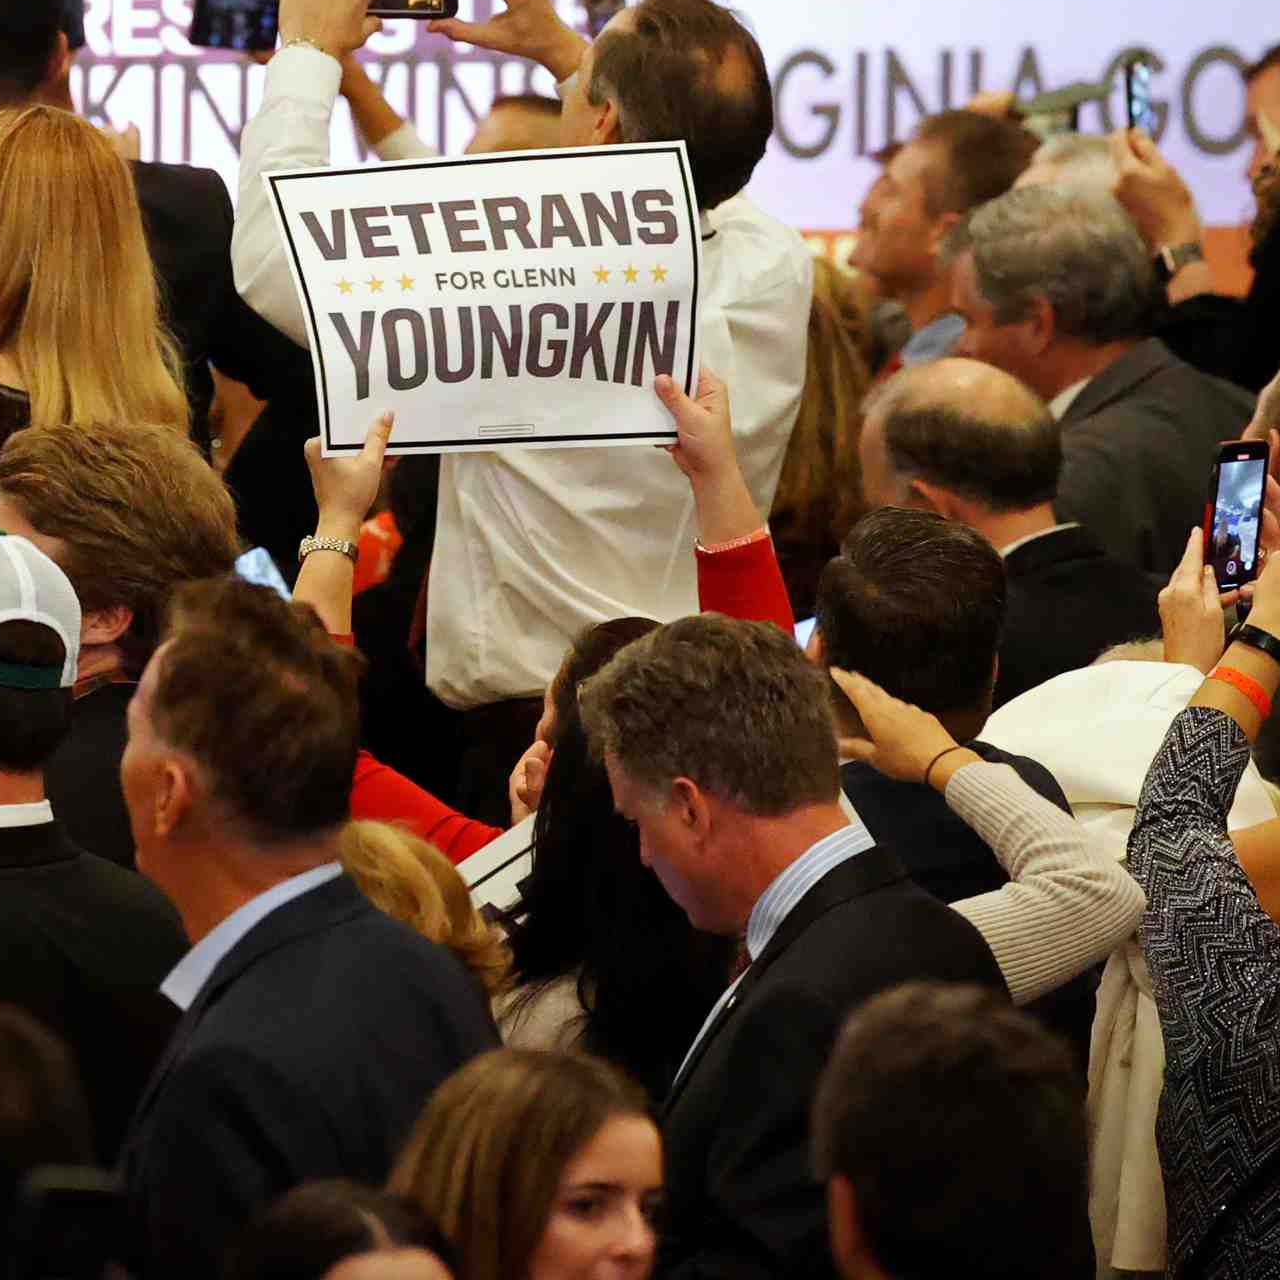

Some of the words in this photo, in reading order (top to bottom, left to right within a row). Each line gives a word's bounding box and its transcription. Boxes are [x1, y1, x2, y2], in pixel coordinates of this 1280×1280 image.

[300, 188, 680, 261] VETERANS
[434, 271, 487, 292] FOR
[493, 267, 577, 289] GLENN
[328, 300, 681, 401] YOUNGKIN
